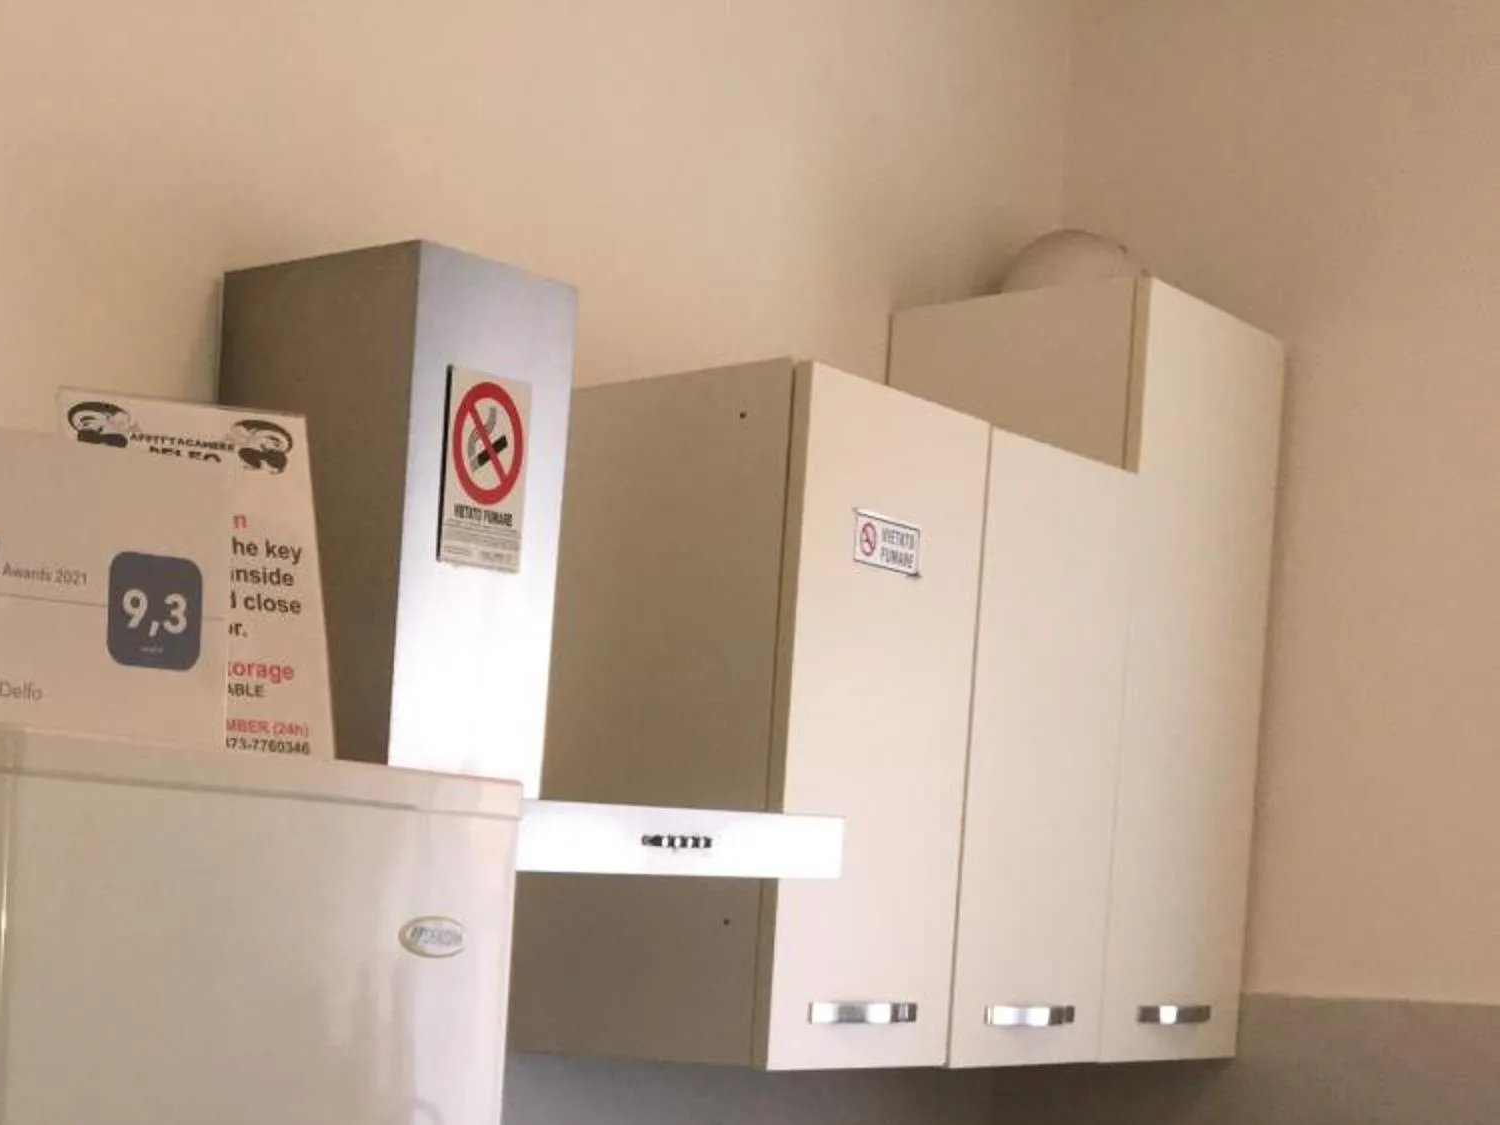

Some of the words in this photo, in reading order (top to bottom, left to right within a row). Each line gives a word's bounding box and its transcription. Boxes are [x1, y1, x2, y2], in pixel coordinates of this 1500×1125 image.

[231, 536, 258, 557] he
[265, 539, 303, 565] key
[2, 561, 52, 582] Awards
[55, 568, 88, 586] 2021
[122, 588, 188, 638] 9,3
[243, 594, 302, 615] close
